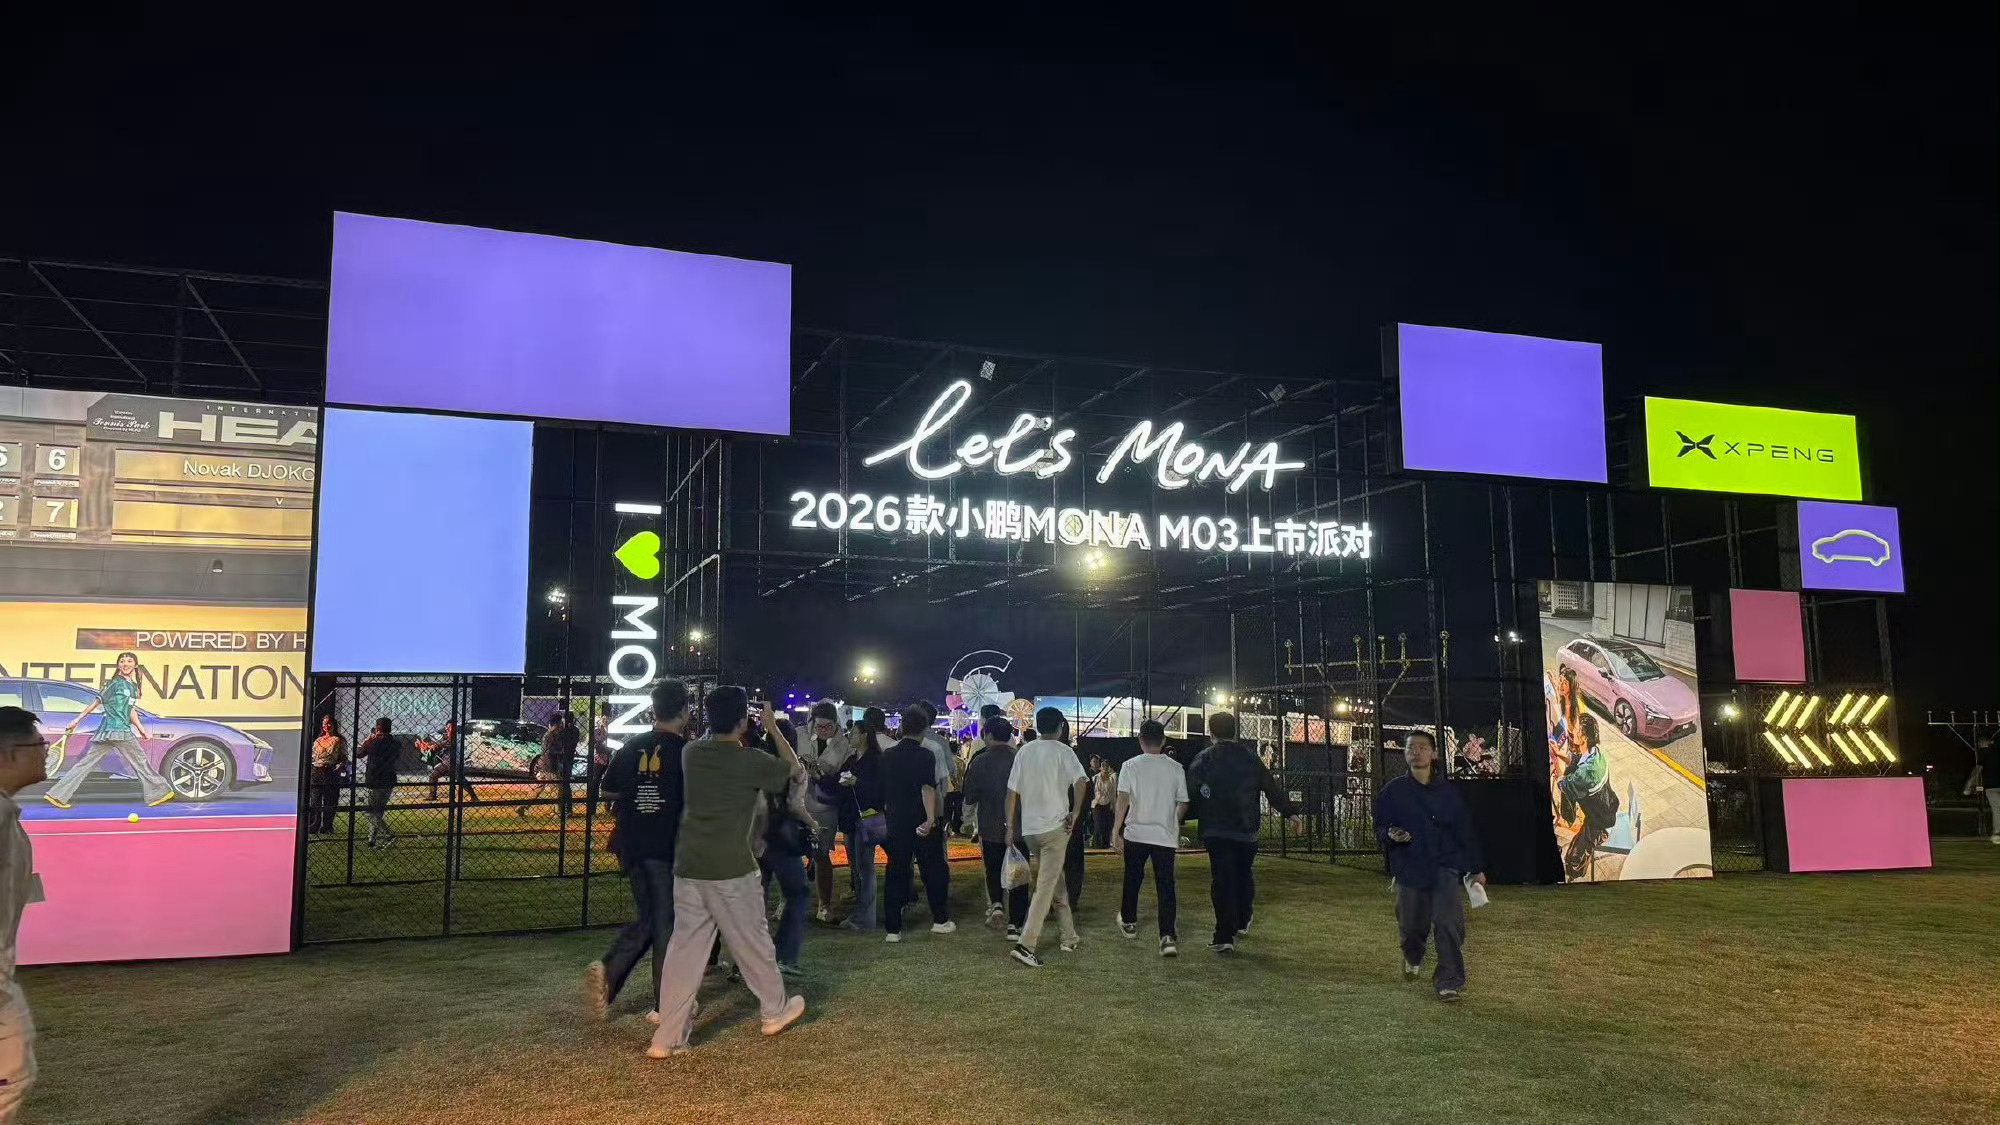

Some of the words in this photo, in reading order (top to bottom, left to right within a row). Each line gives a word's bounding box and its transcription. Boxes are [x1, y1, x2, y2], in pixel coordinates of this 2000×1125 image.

[205, 404, 312, 418] INTERNATI
[158, 411, 317, 446] HEA
[48, 448, 67, 471] 6
[1724, 441, 1835, 463] XPENG
[183, 460, 242, 477] Novak
[247, 463, 315, 481] DJOKO
[46, 501, 65, 523] 7
[614, 502, 662, 515] I
[135, 631, 247, 649] POWERED
[256, 633, 284, 649] BY
[606, 595, 660, 750] MON
